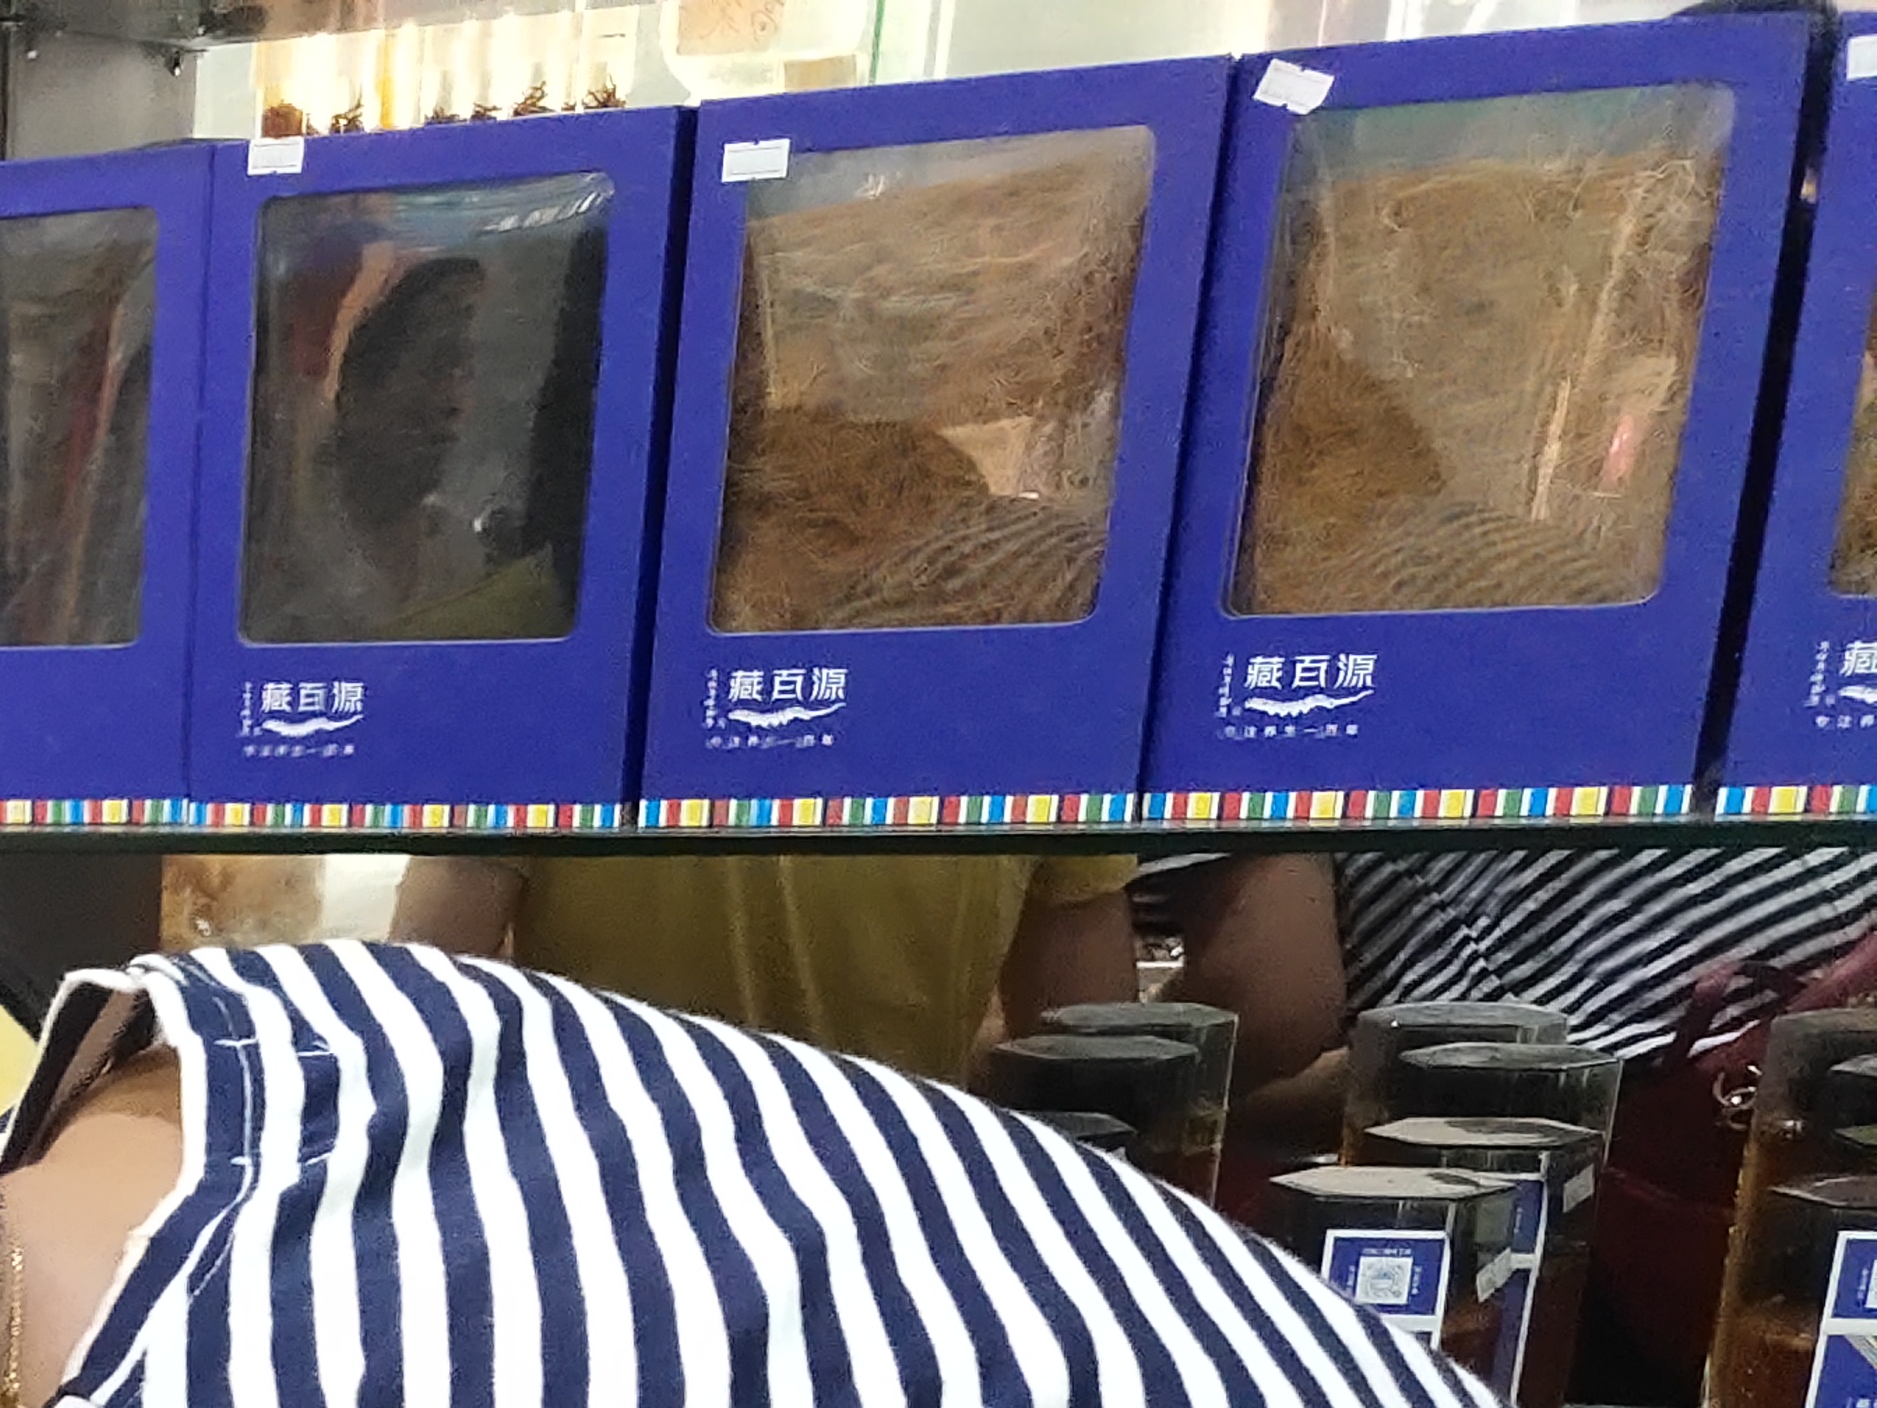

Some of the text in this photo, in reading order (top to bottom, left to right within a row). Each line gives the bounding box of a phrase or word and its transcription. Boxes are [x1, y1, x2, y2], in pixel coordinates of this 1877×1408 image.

[728, 666, 849, 703] 藏百源
[1243, 653, 1378, 691] 藏百源
[261, 680, 366, 714] 藏百源
